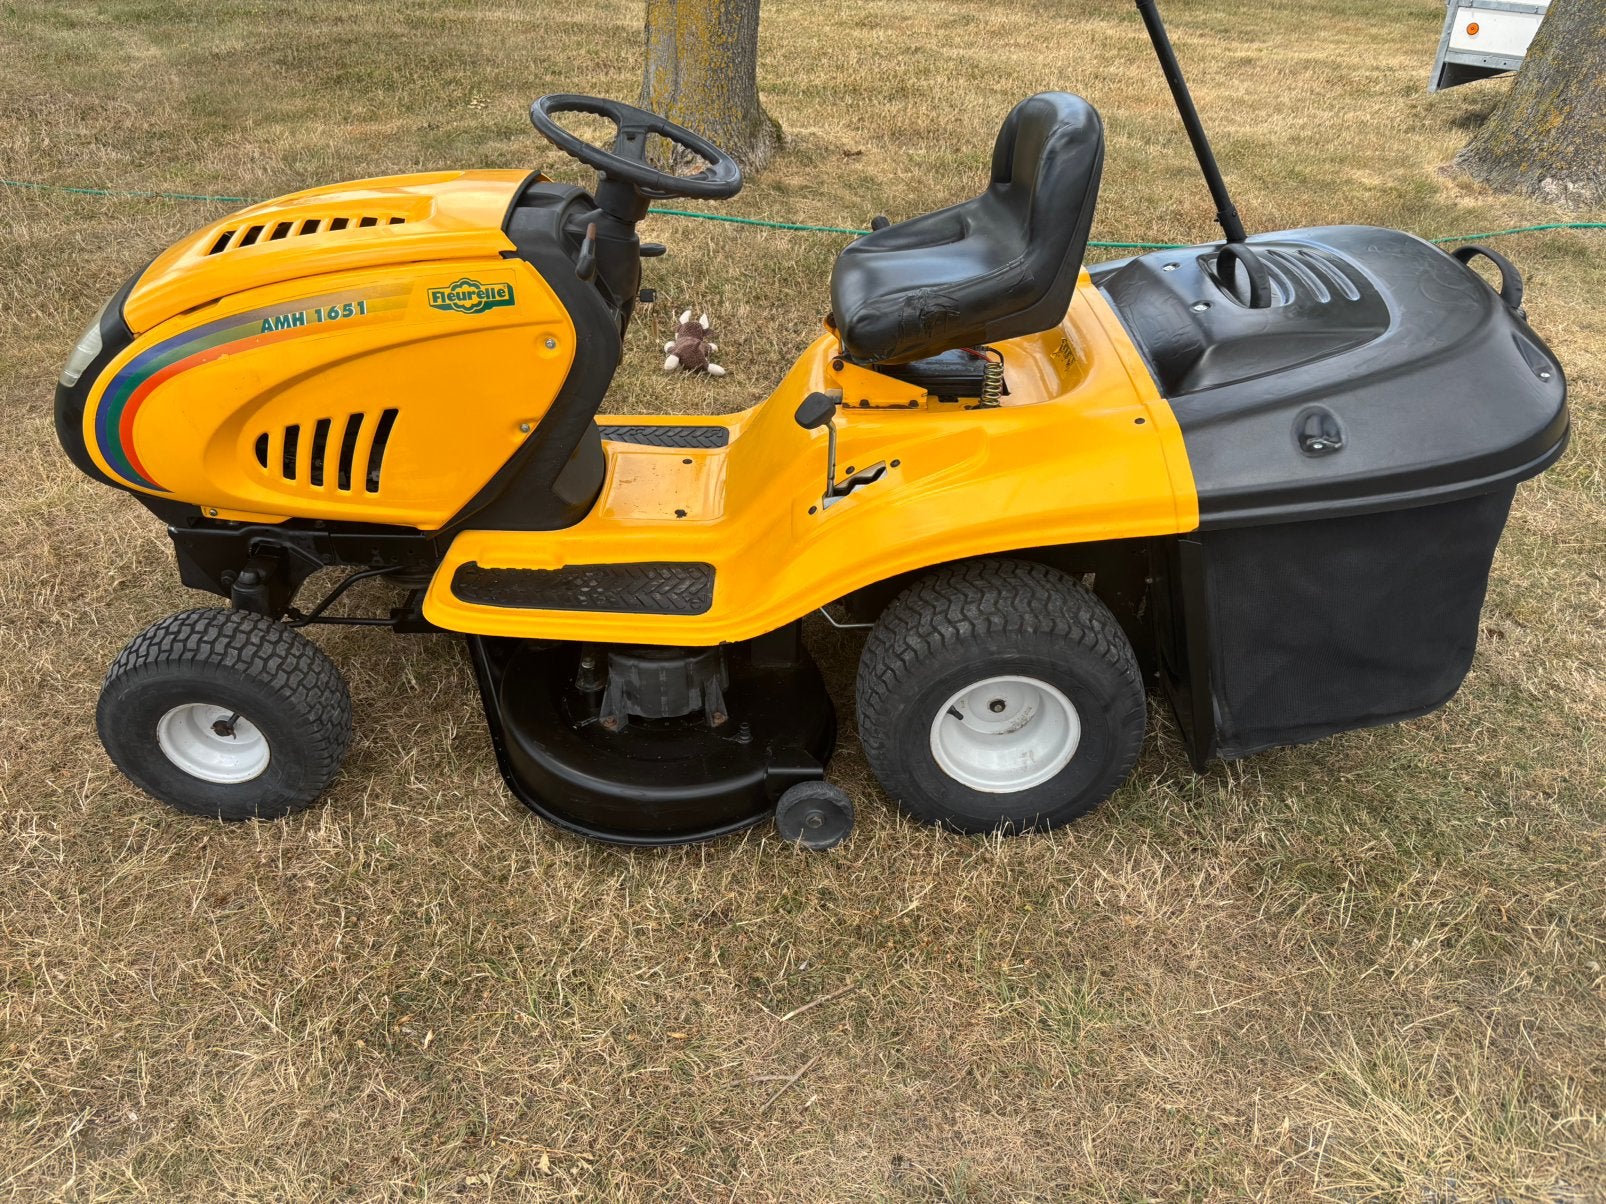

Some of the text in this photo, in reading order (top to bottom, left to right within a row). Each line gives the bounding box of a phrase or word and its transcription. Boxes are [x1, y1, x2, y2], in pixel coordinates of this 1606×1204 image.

[431, 287, 507, 304] Fleurelle
[261, 300, 367, 333] AMH 1651
